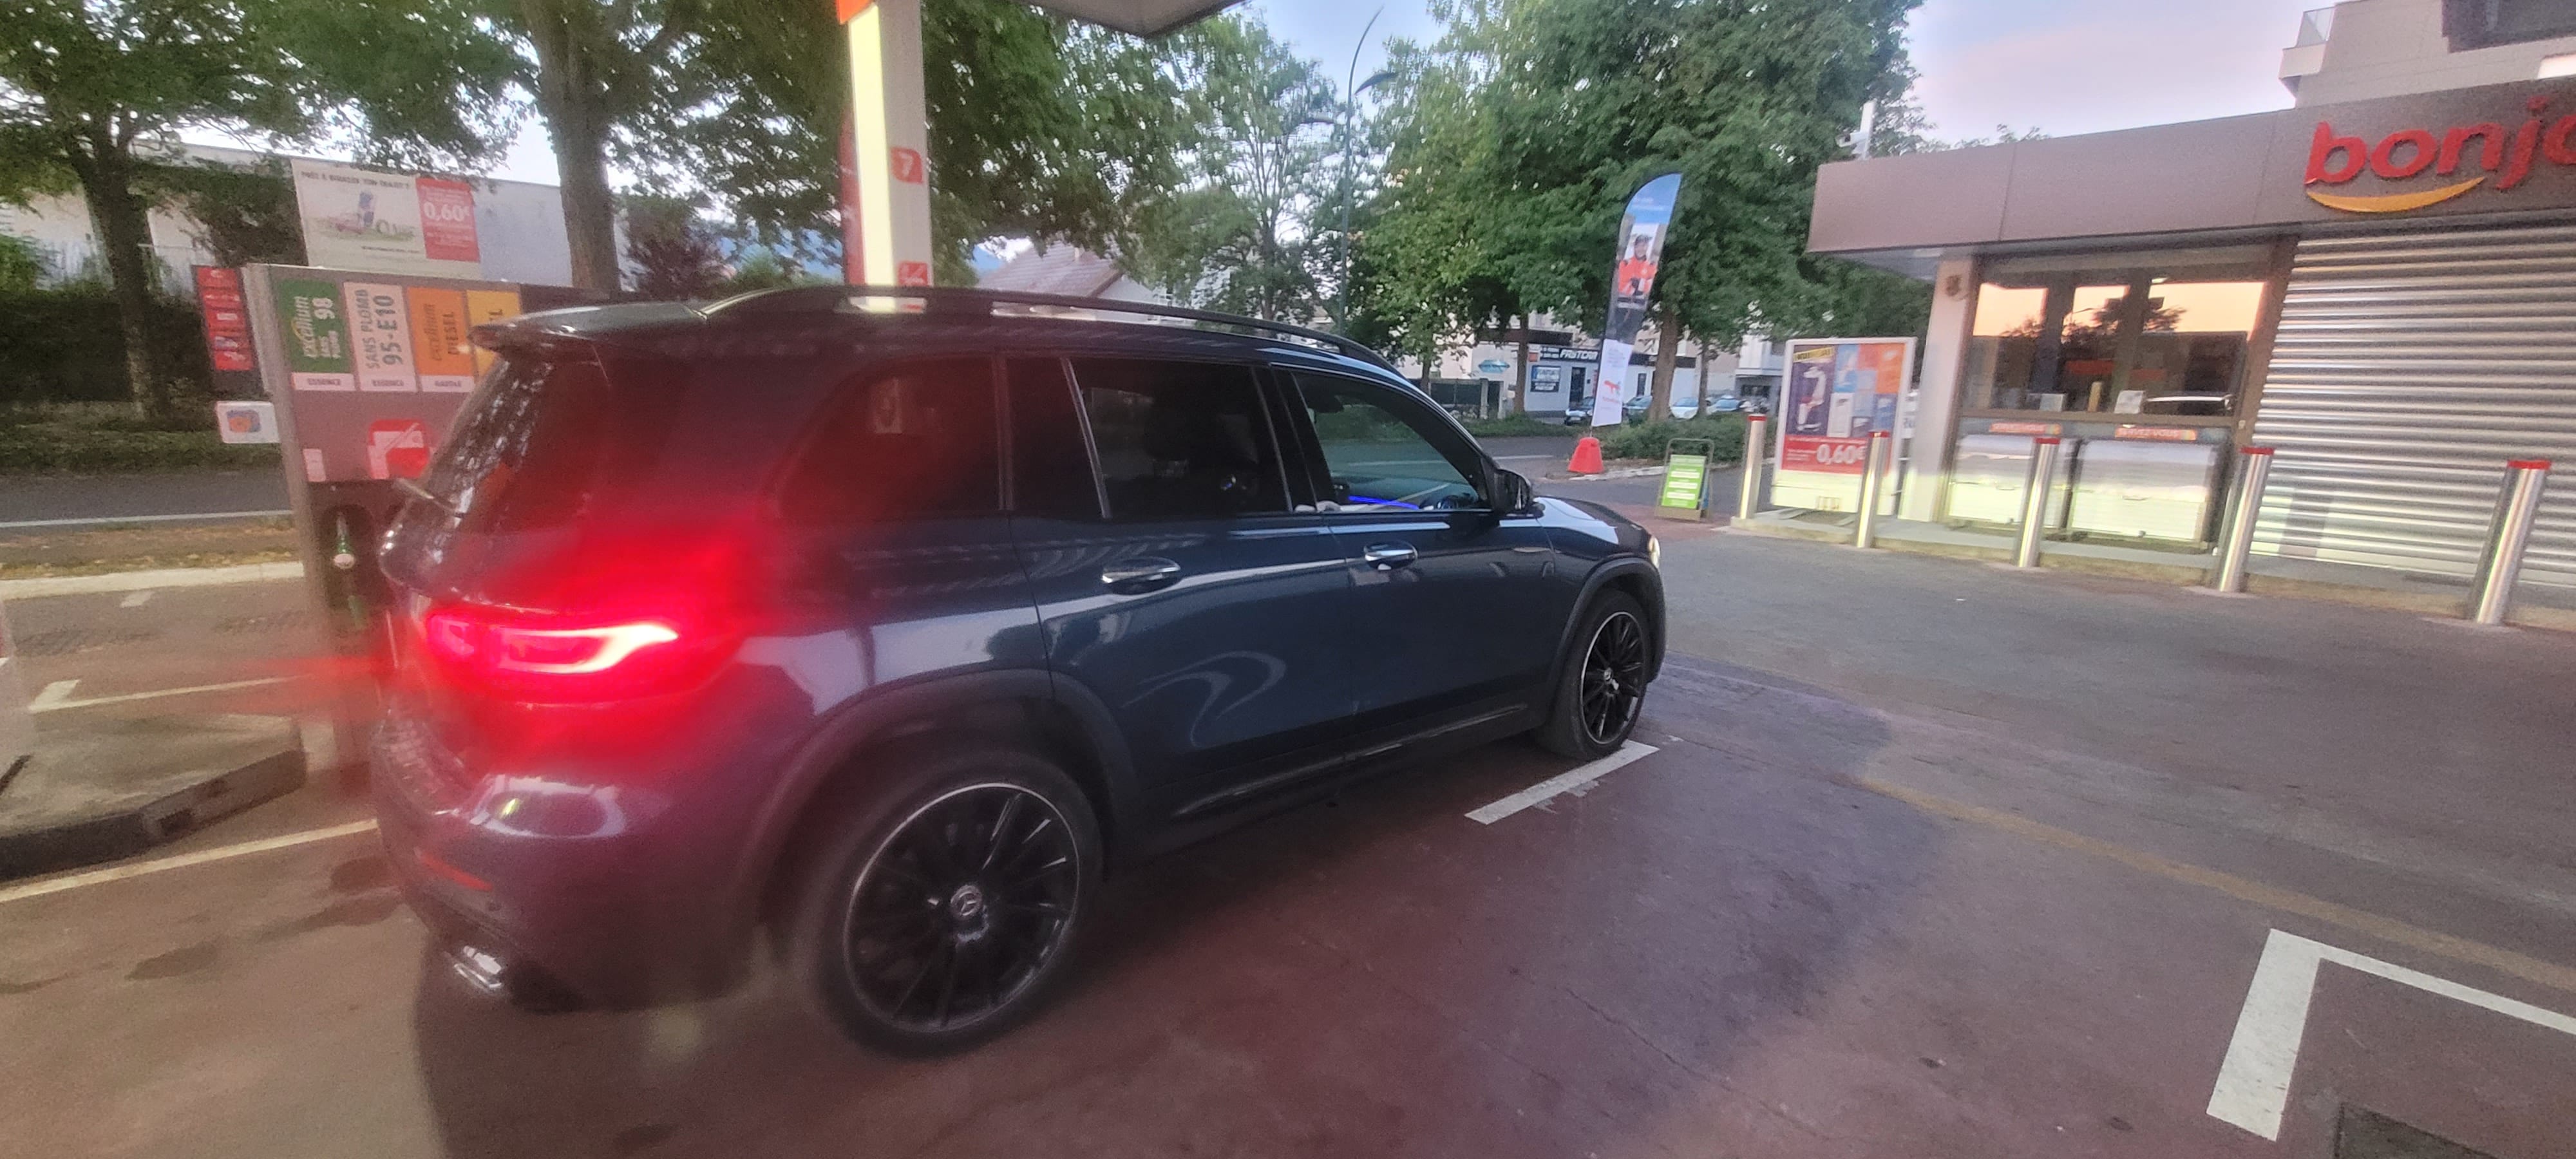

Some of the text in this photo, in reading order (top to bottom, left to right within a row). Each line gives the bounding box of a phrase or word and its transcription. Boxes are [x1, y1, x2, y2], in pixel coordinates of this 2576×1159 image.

[897, 150, 913, 175] 7
[312, 297, 336, 320] 98
[355, 289, 381, 370] SANS PLOMB
[372, 294, 403, 366] 95-E10
[443, 311, 460, 355] DIESEL
[1816, 444, 1866, 464] 0,60€
